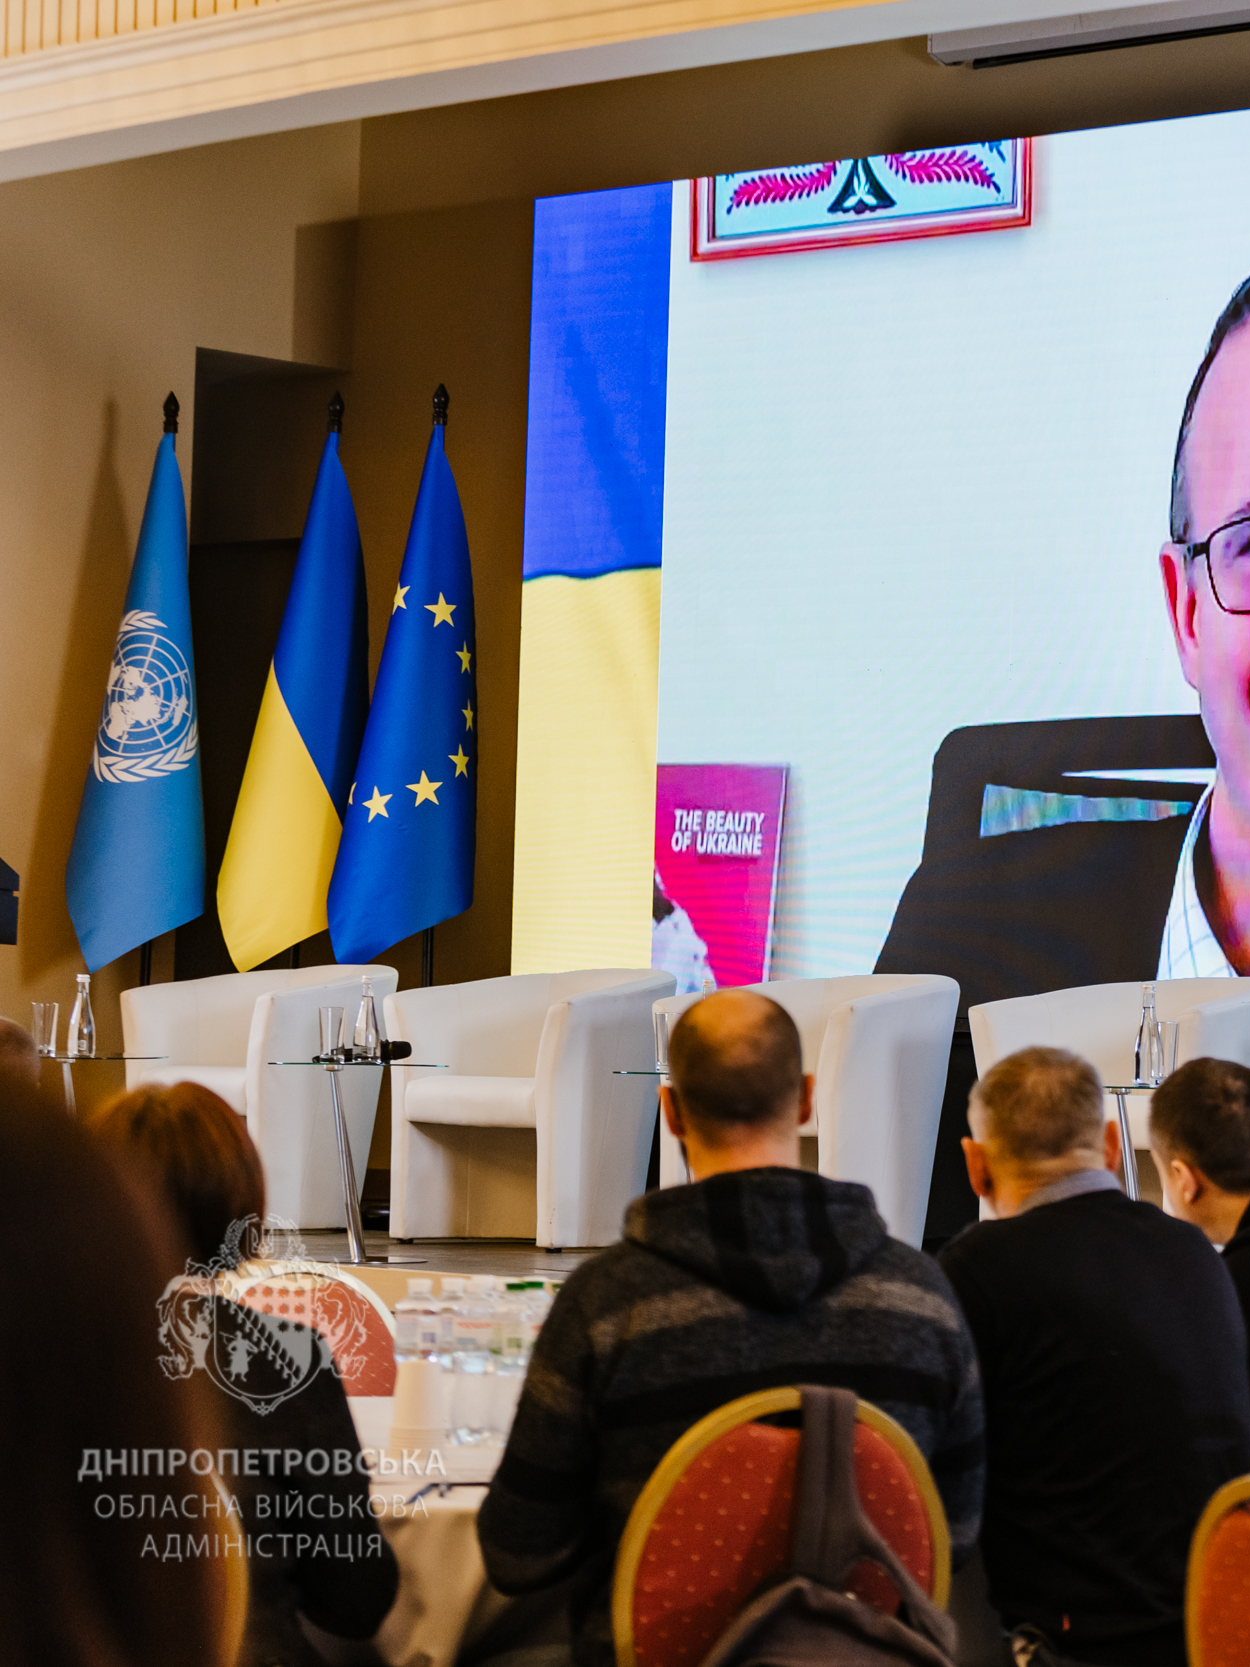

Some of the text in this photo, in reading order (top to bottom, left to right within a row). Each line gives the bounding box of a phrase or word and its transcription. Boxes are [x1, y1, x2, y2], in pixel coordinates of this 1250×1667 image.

[674, 808, 765, 833] THE BEAUTY
[671, 831, 763, 855] OF UKRAINE
